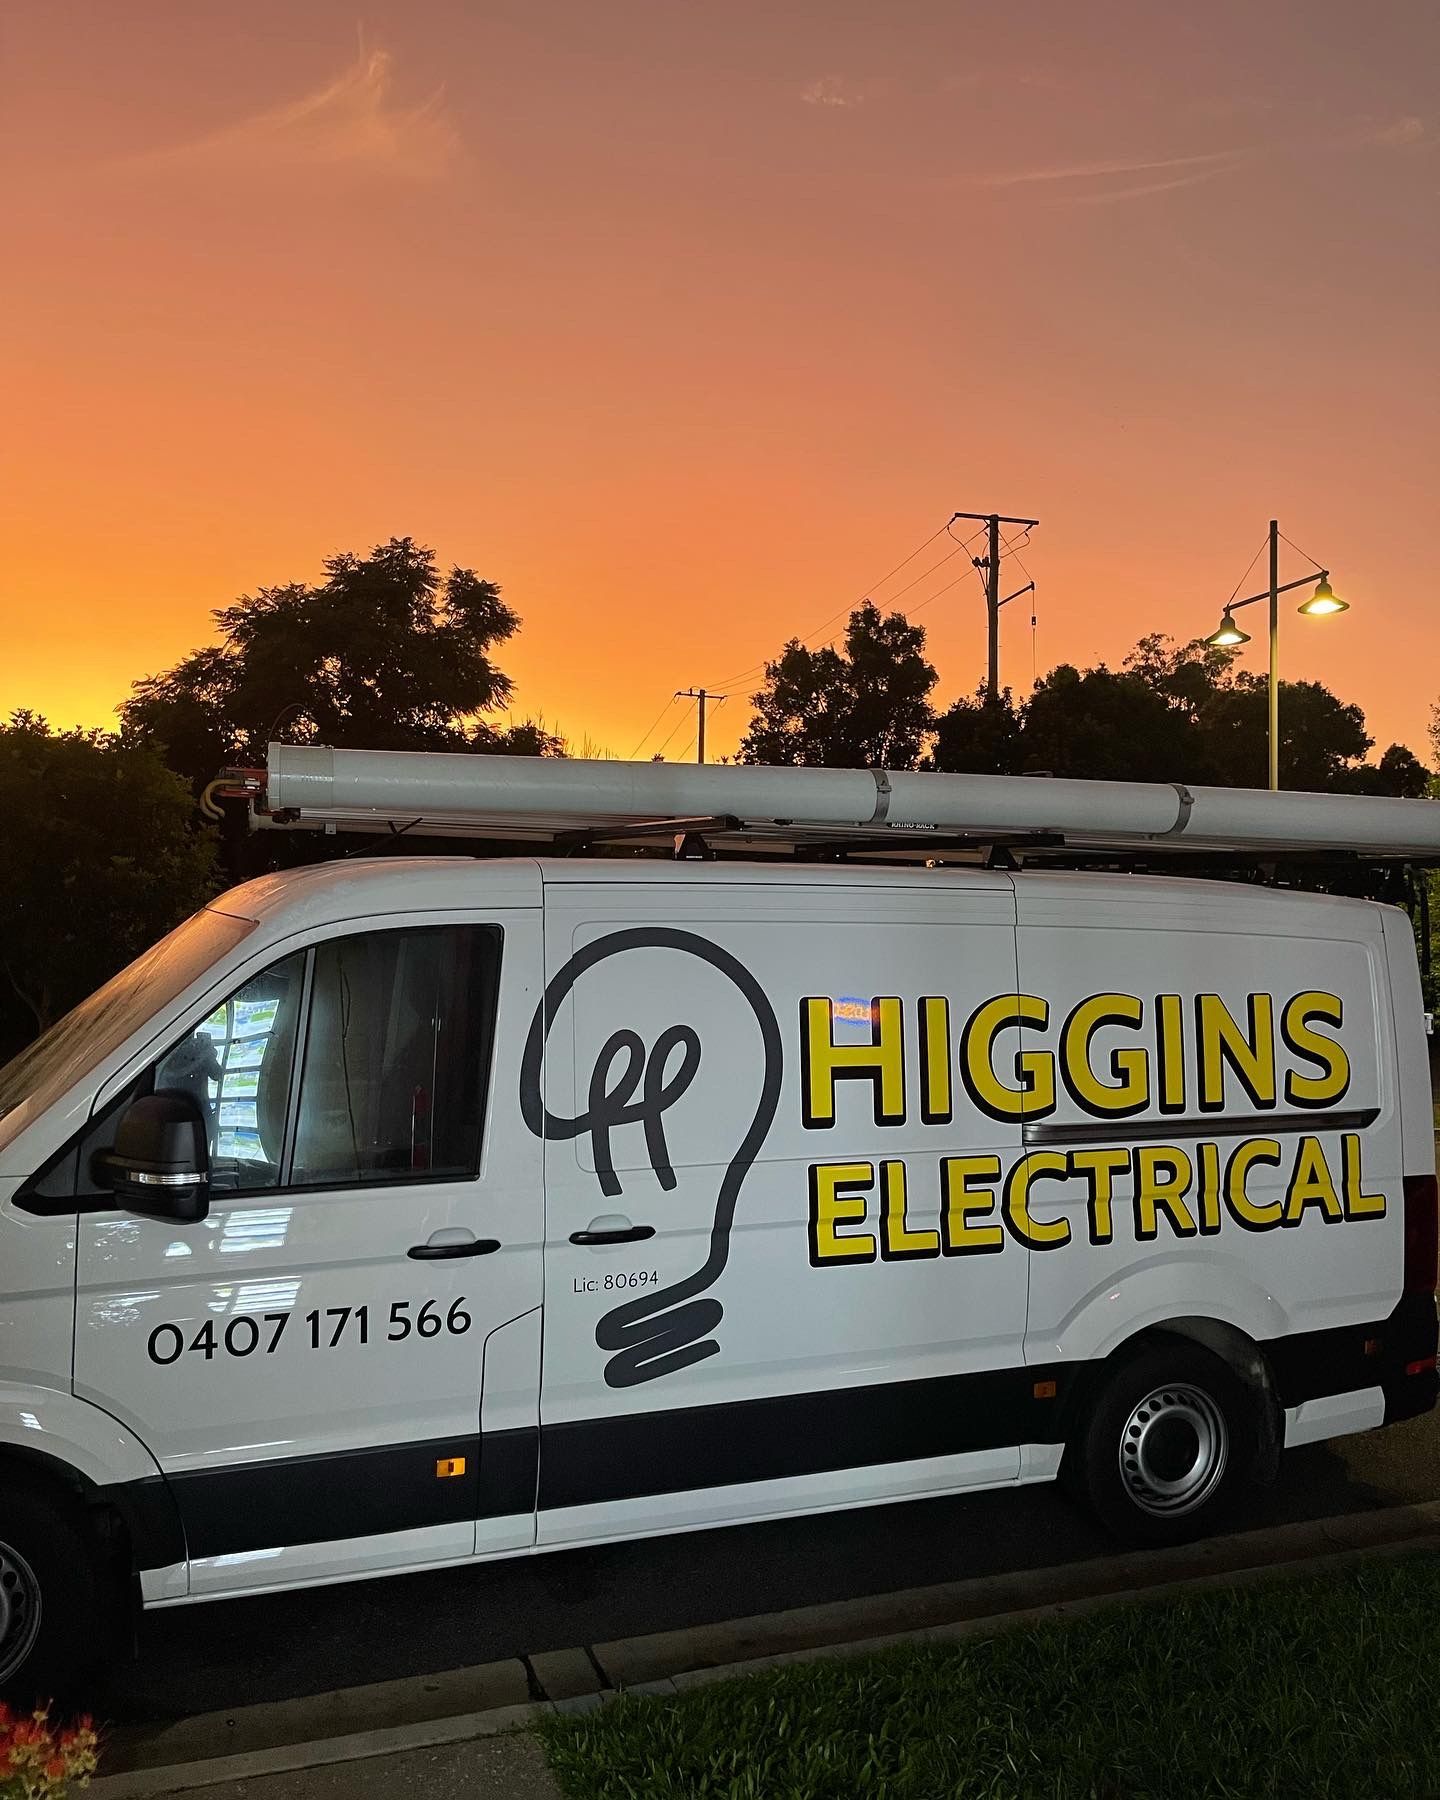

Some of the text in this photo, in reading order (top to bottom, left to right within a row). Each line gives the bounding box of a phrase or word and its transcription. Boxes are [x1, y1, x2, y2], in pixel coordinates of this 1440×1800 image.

[800, 991, 1350, 1129] HIGGINS
[808, 1134, 1387, 1267] ELECTRICAL
[147, 1296, 472, 1365] 0407 171 566
[573, 1270, 659, 1293] Lic: 80694
